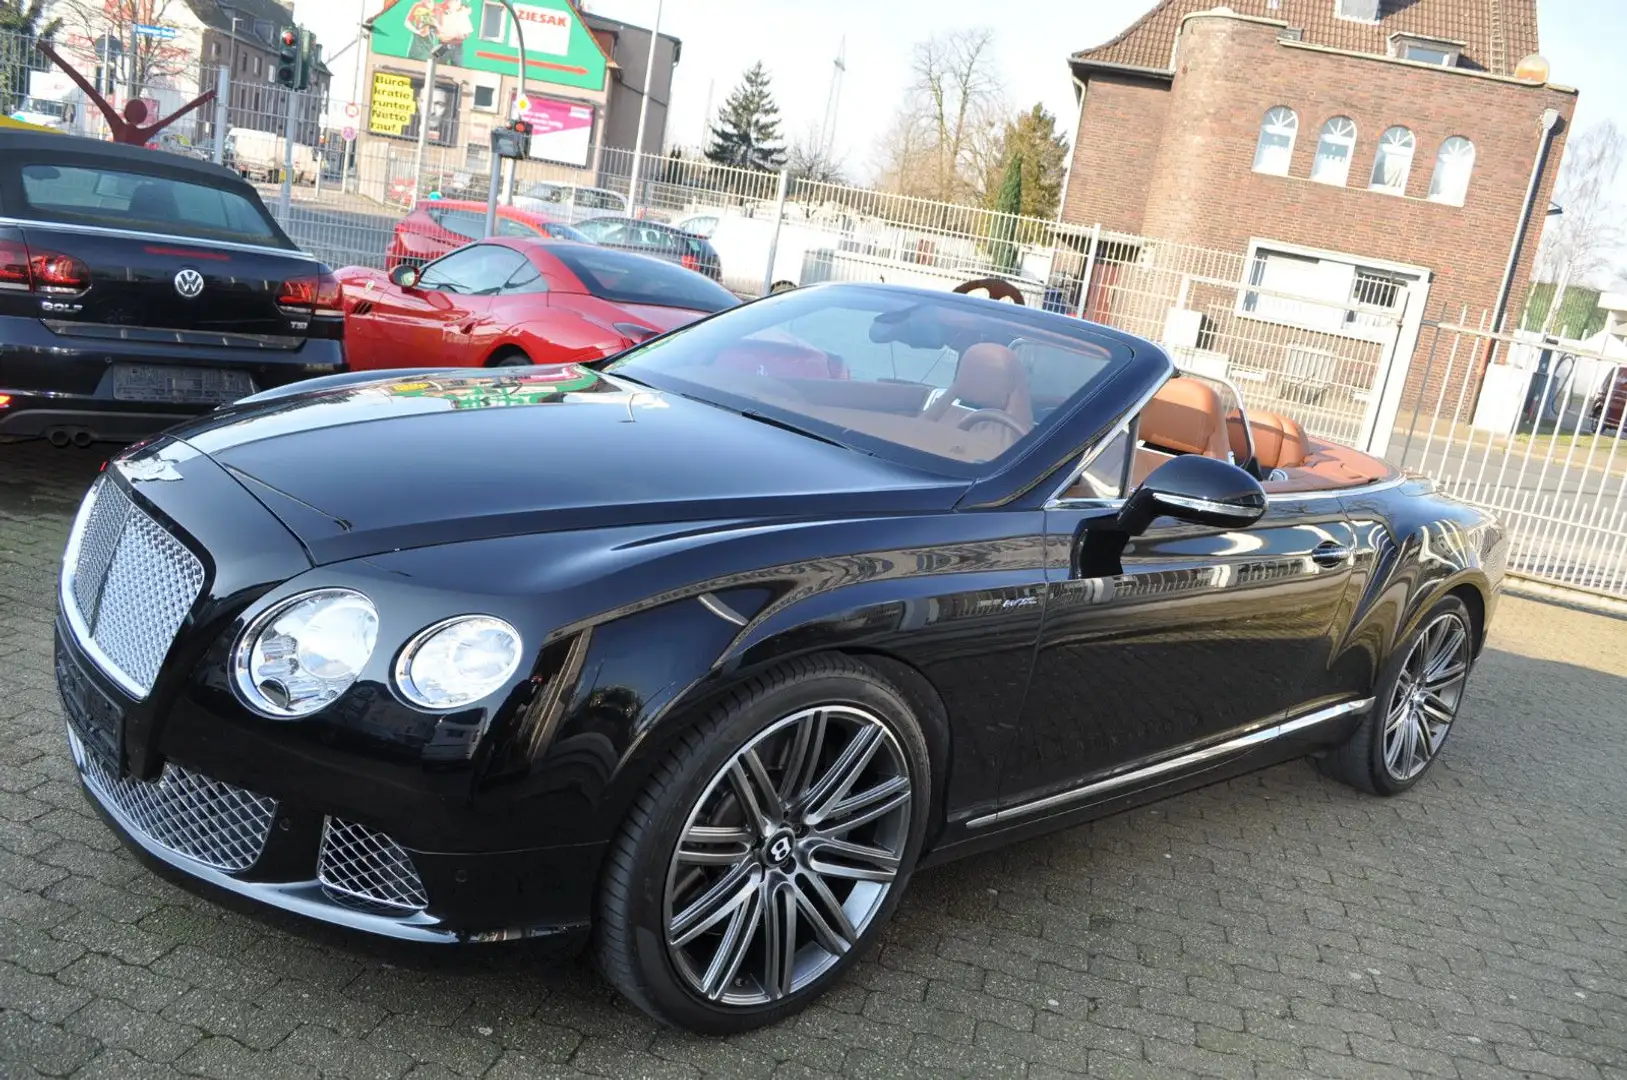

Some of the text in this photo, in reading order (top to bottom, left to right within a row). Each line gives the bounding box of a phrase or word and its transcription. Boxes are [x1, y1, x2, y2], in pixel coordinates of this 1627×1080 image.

[518, 9, 567, 27] ZIESAK
[374, 86, 410, 99] kratie
[371, 109, 407, 122] Netto
[41, 300, 83, 313] GOLF
